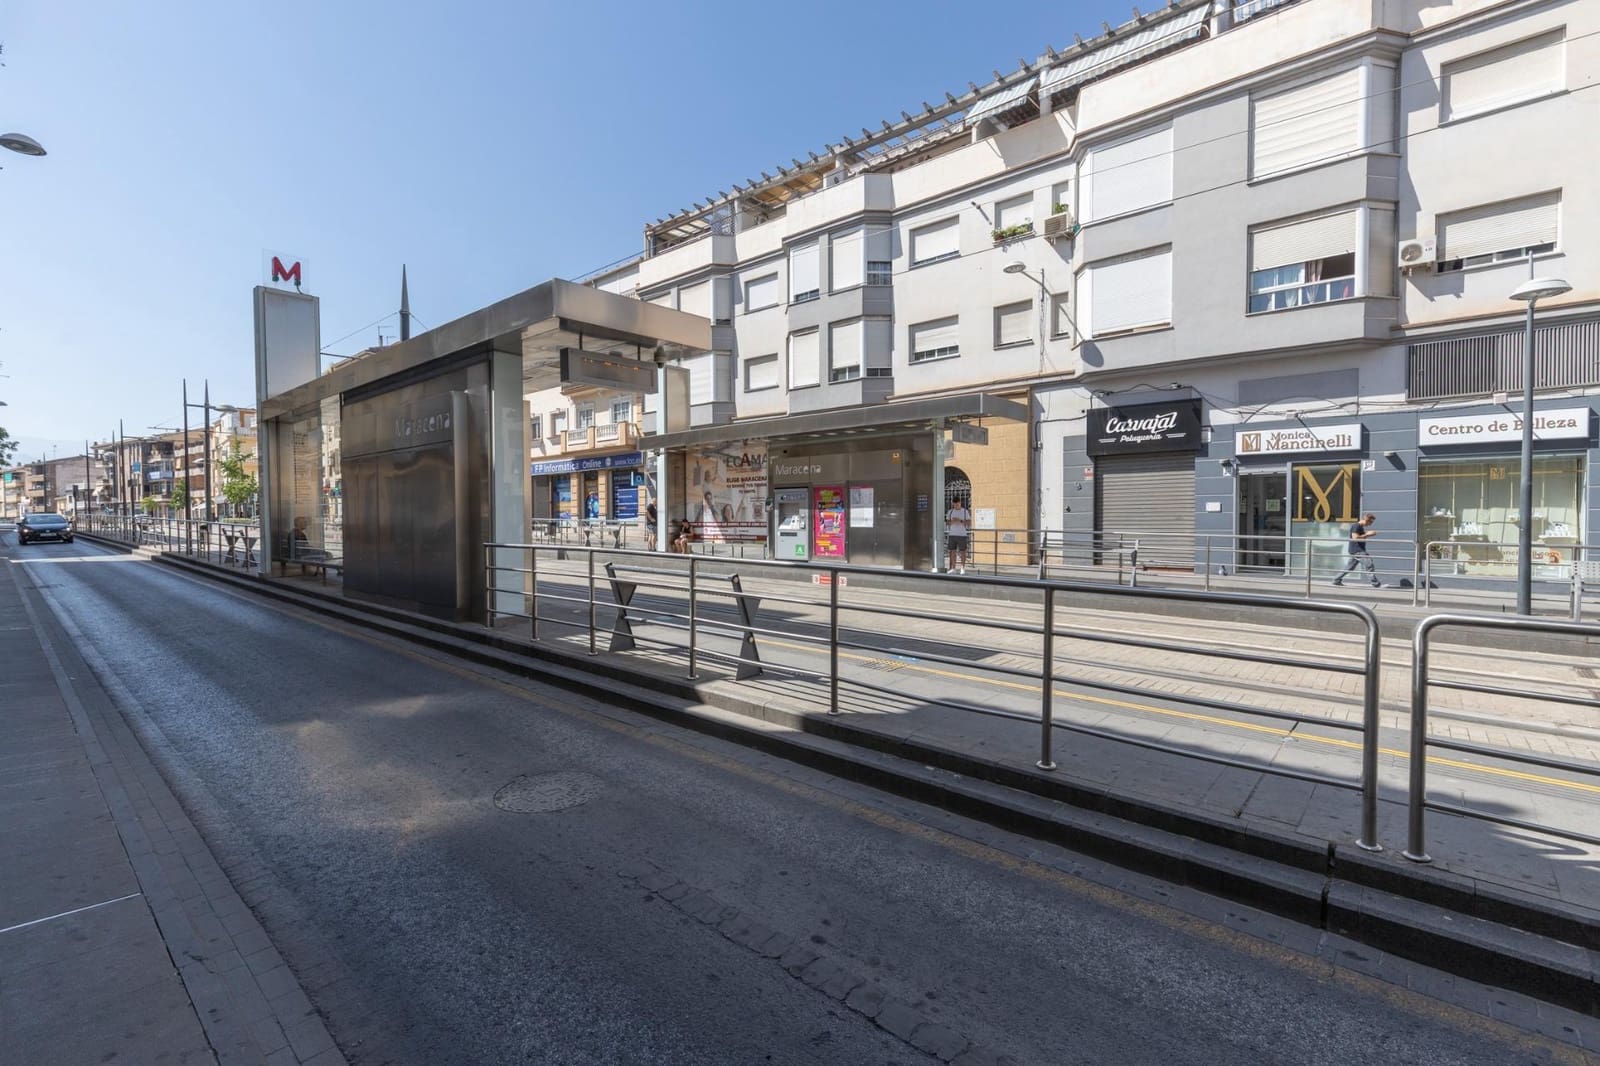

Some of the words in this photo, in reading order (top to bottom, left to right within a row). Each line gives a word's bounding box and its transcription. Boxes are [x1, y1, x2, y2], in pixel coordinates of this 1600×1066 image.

[272, 256, 301, 286] M
[393, 412, 450, 437] Maracena
[1106, 412, 1178, 434] Carvajal
[1428, 425, 1483, 436] Centro
[1488, 421, 1508, 432] de
[1513, 417, 1577, 431] Blleza
[1266, 434, 1352, 451] Mancinelli
[775, 464, 821, 475] Maracena
